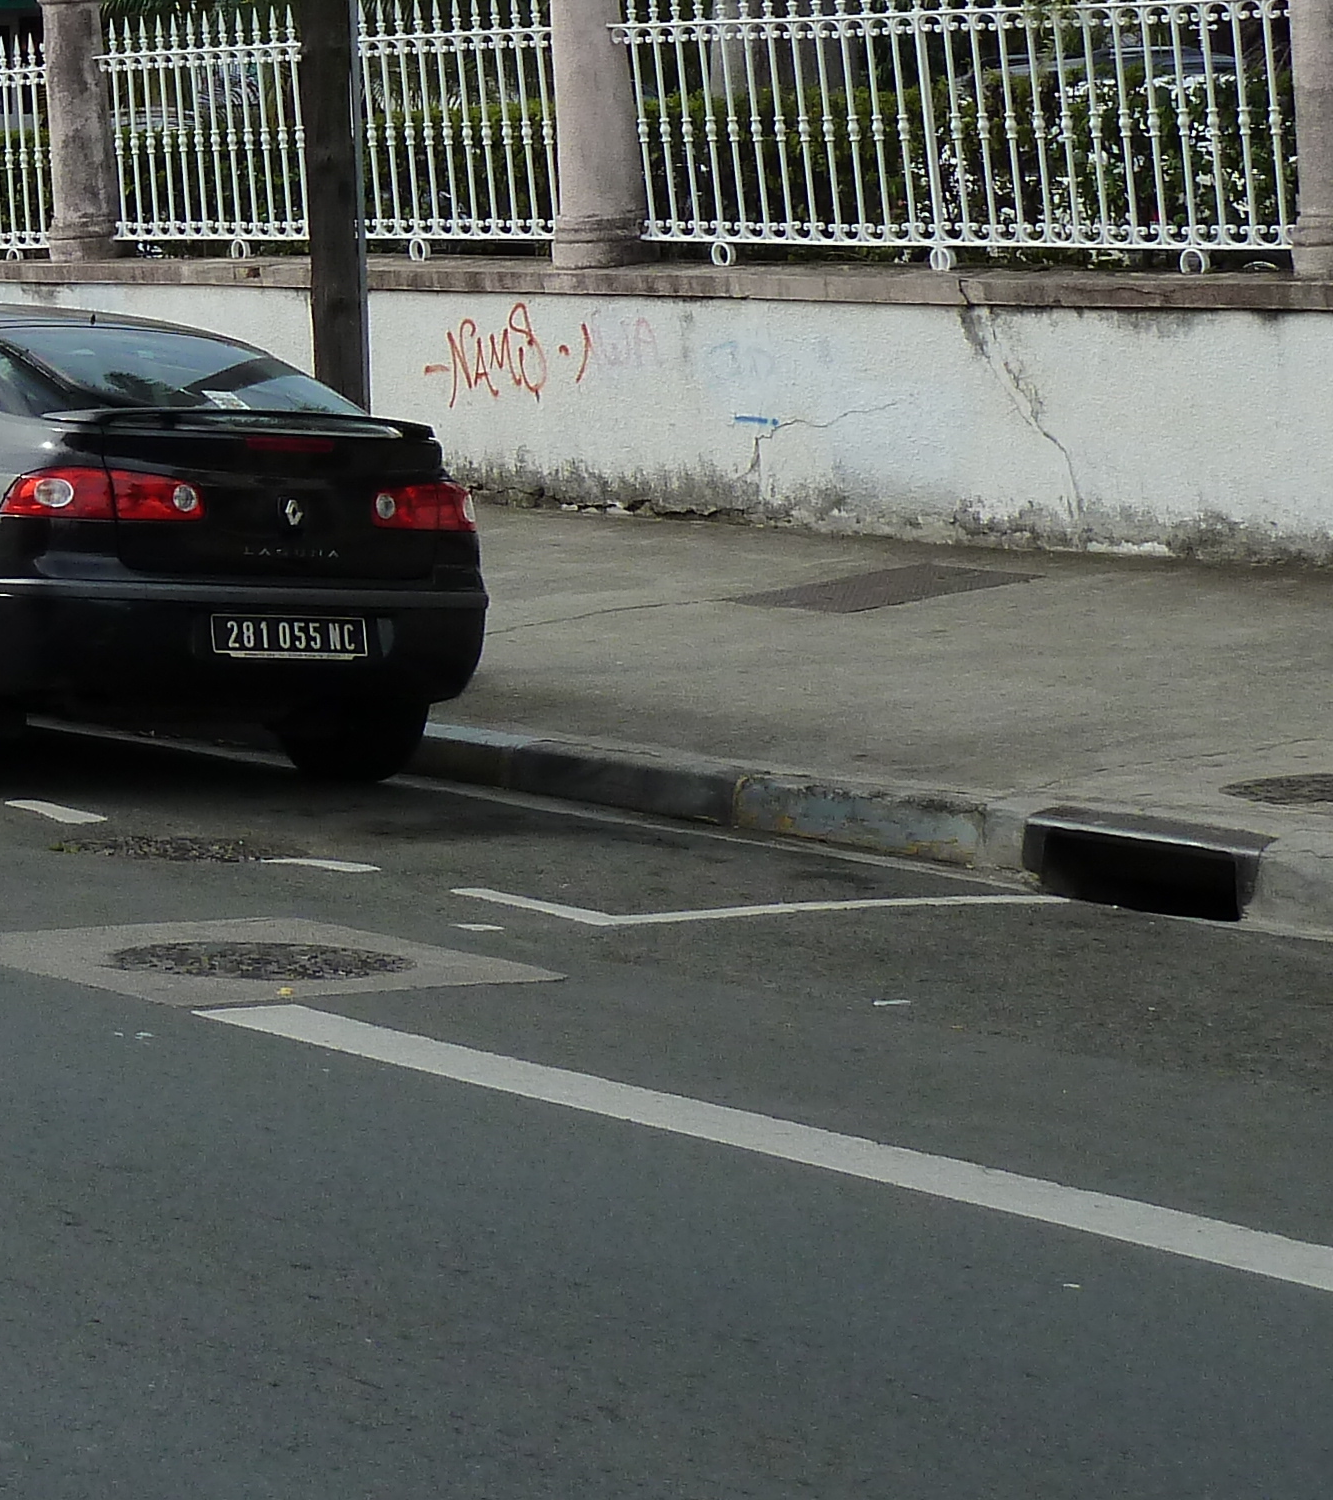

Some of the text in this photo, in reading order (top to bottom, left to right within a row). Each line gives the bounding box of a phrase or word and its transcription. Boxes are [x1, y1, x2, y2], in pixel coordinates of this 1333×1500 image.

[226, 620, 356, 651] 281 055 NC
